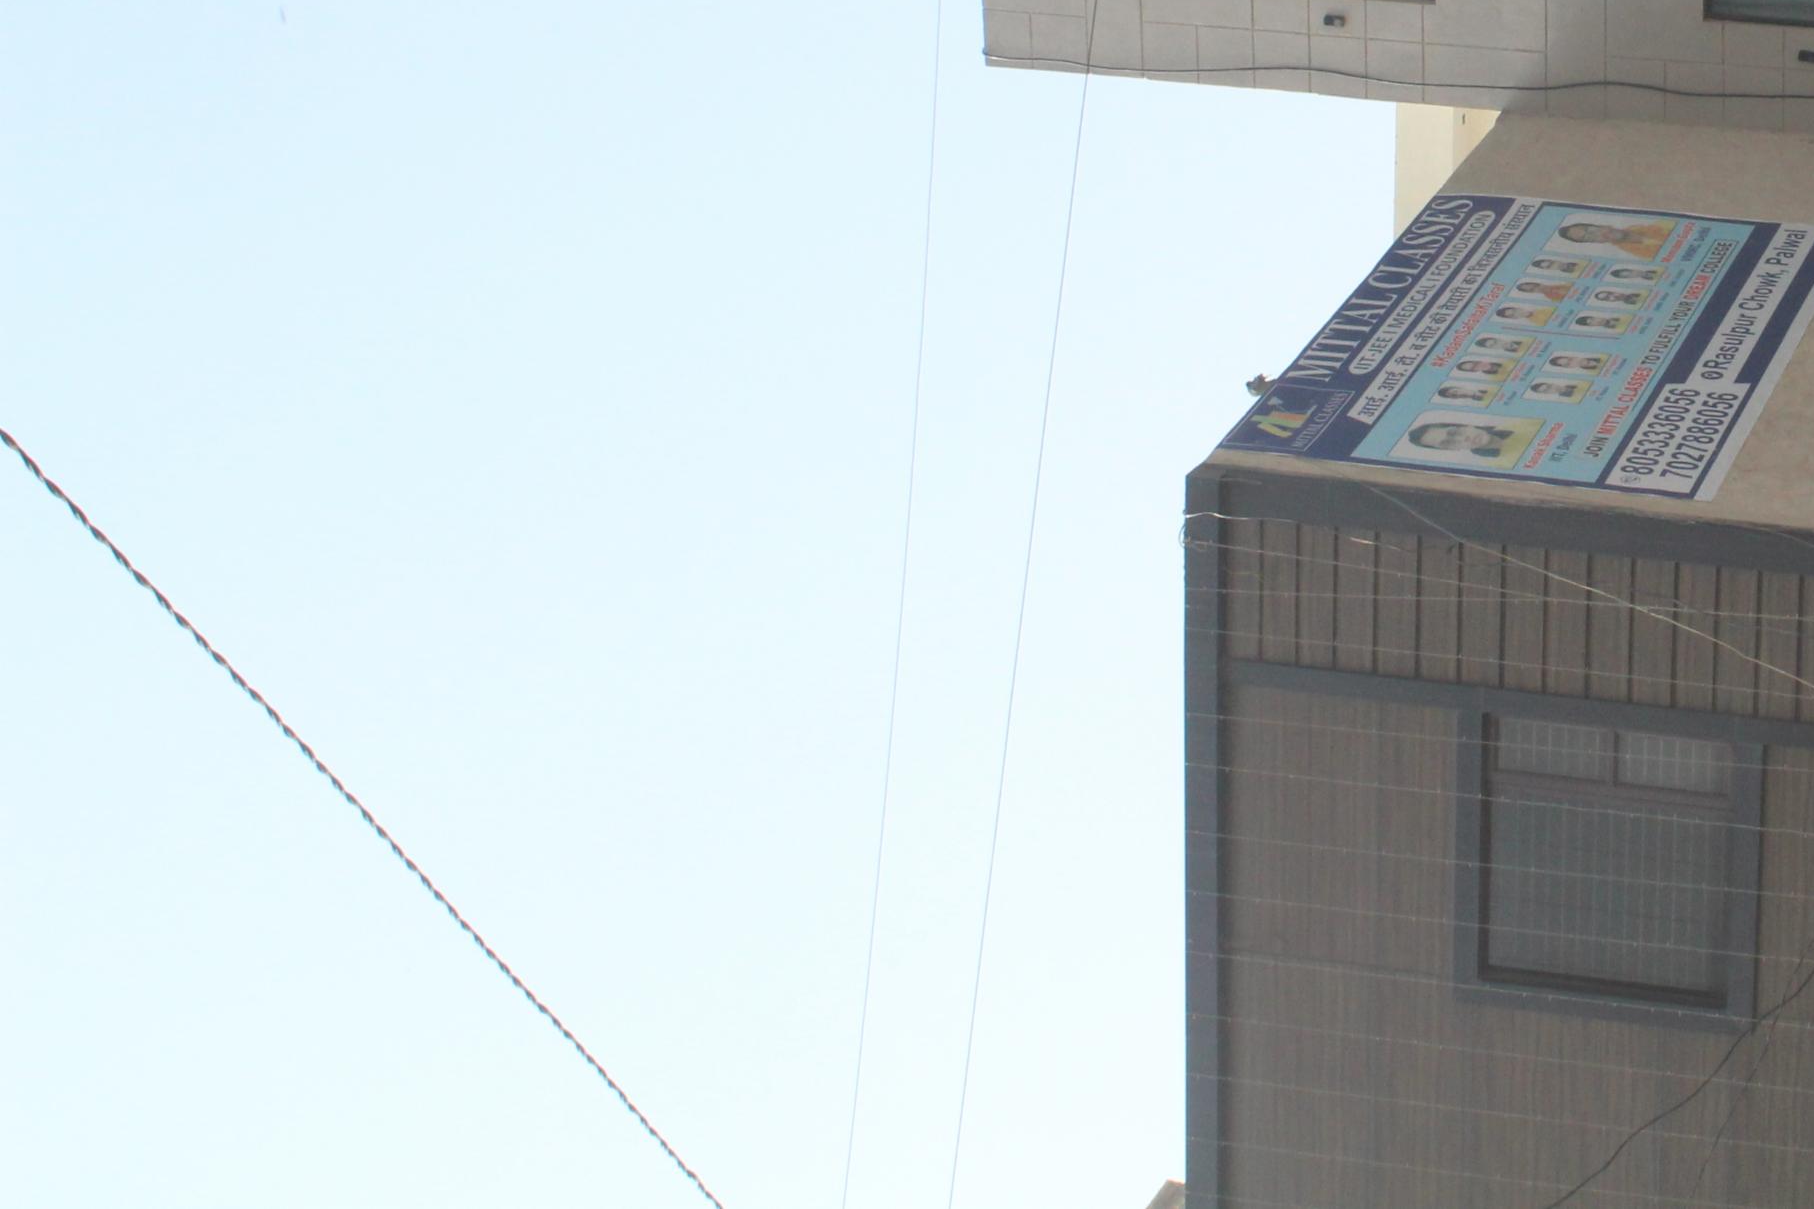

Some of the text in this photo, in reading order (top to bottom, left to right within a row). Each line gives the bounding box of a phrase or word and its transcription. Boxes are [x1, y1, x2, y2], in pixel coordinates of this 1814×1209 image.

[1698, 241, 1733, 273] COLLEGE
[1286, 197, 1475, 382] MITTAL CLASSES
[1353, 336, 1393, 371] IIT-JEE
[1390, 284, 1436, 328] MEDICAL
[1430, 213, 1491, 276] FOUNDATION
[1683, 273, 1711, 300] DREAM
[1701, 229, 1809, 370] Rasulpur Chowk, Palwal
[1668, 301, 1696, 321] YOUR
[1645, 323, 1681, 353] FULFILL
[1640, 355, 1661, 365] TO
[1617, 367, 1653, 403] CLASSES
[1596, 405, 1630, 435] MITTAL
[1620, 388, 1701, 475] 8053336056
[1660, 391, 1739, 478] 7027886056
[1583, 435, 1608, 457] JOIN
